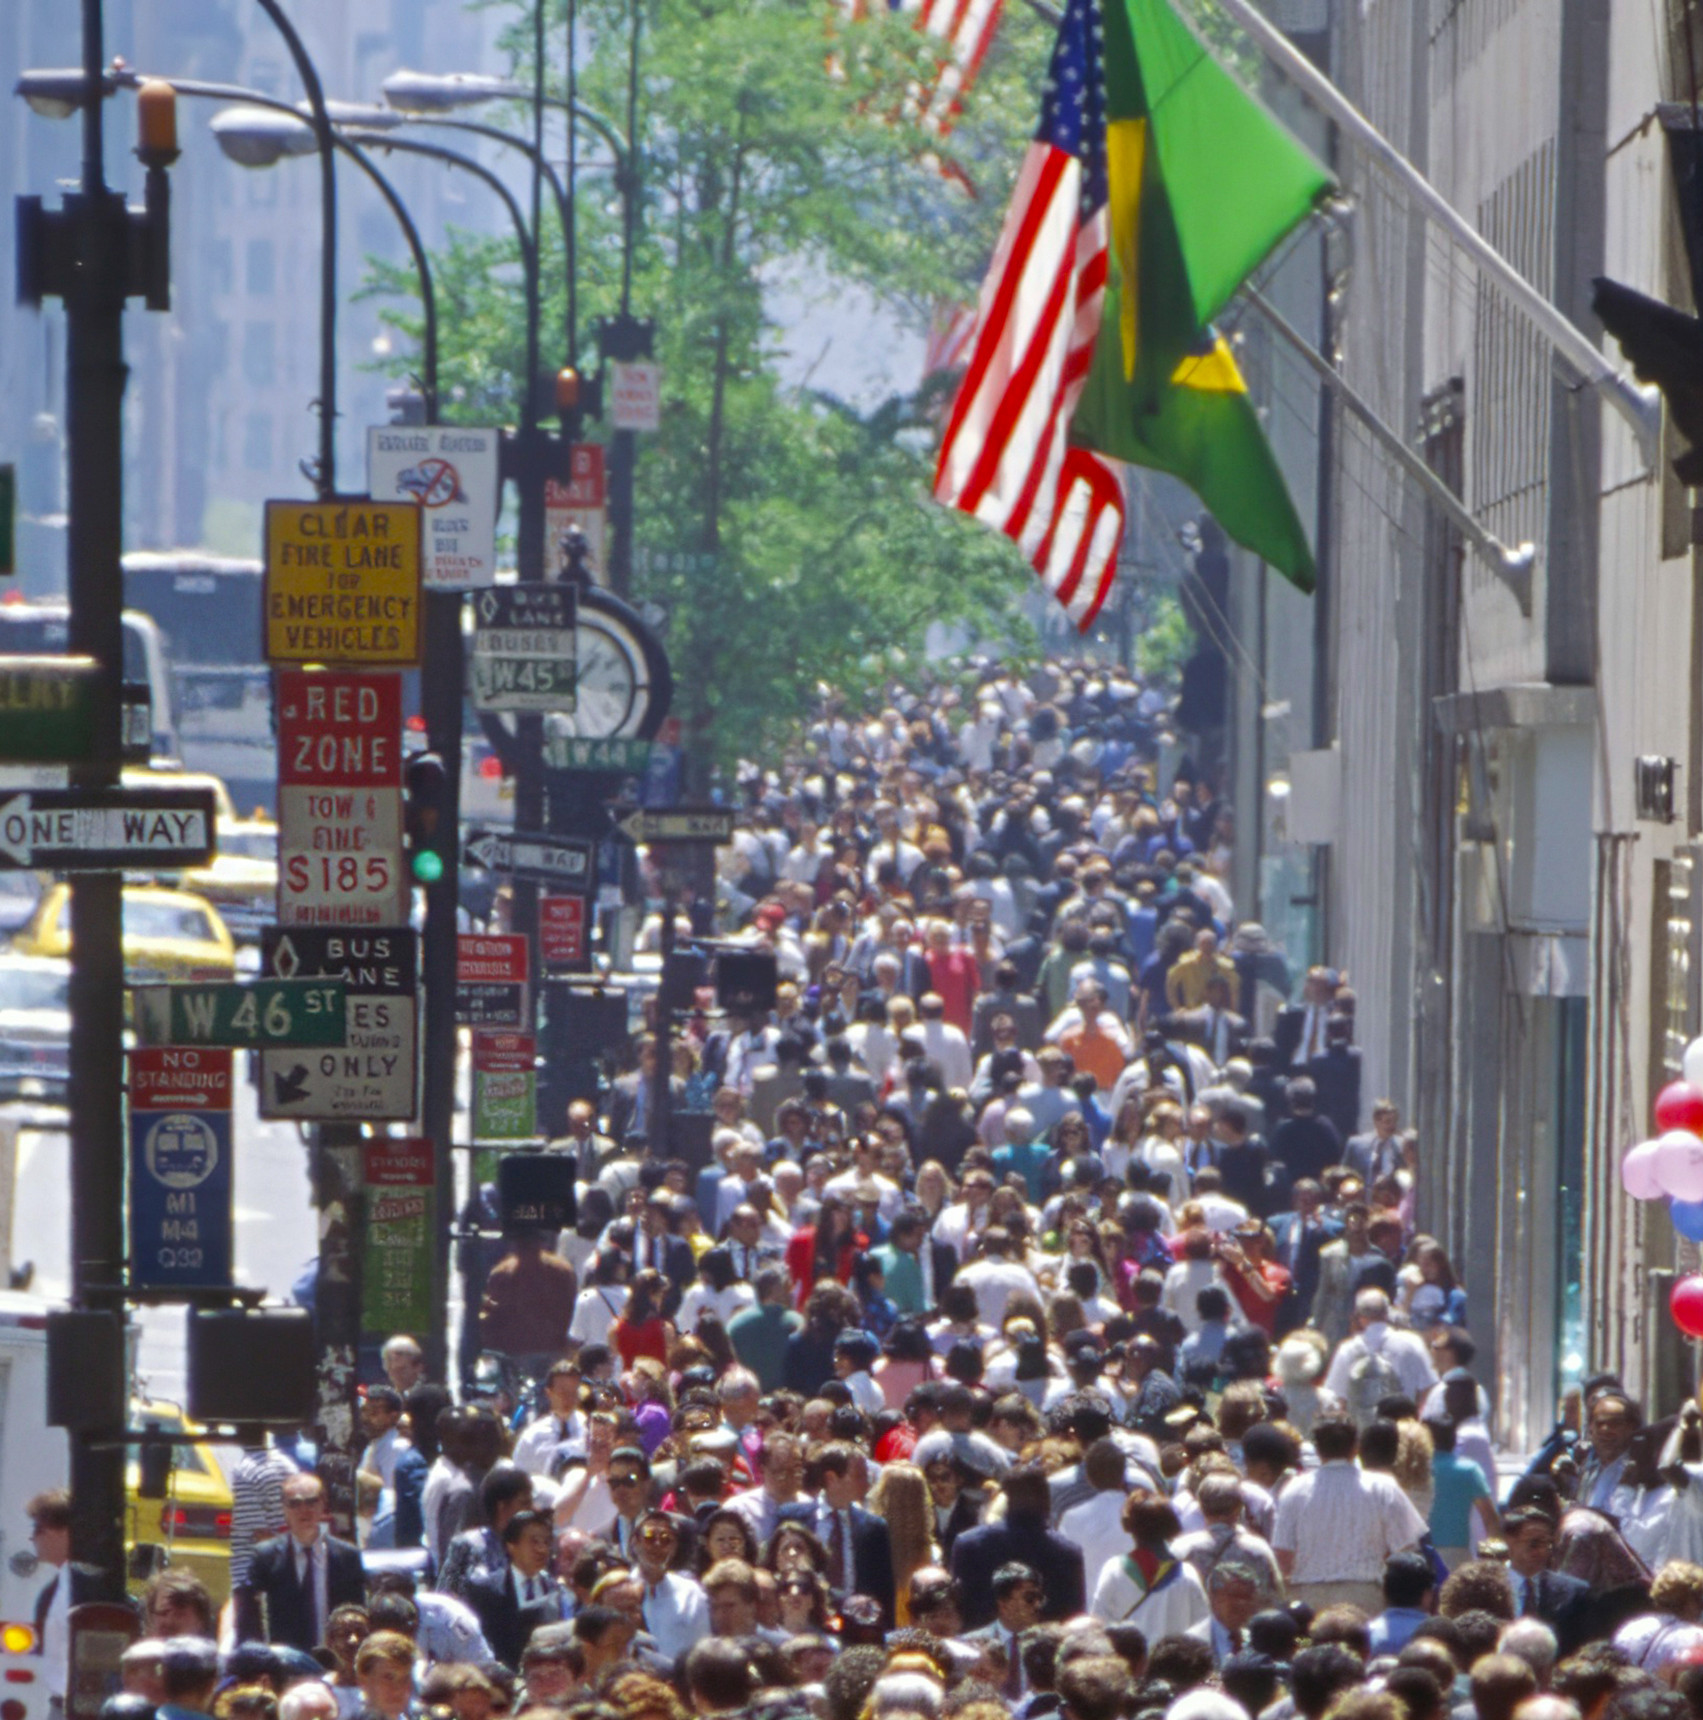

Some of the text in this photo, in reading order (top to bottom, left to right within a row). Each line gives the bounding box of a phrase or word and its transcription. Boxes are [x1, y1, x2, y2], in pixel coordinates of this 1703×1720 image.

[298, 513, 390, 538] CLEAR
[281, 542, 334, 567] FIRE
[346, 544, 404, 569] LANE
[271, 592, 412, 619] EMERGENCY
[285, 625, 401, 651] VEHICLES
[496, 661, 515, 690] W
[516, 661, 554, 692] 45
[306, 686, 379, 723] RED
[295, 734, 388, 774] ZONE
[308, 795, 353, 819] TOW
[4, 812, 195, 845] ONE WAY
[327, 938, 391, 959] BUS
[319, 966, 400, 987] ANE
[183, 988, 337, 1042] W 46 ST
[162, 1051, 200, 1069] NO
[319, 1054, 399, 1078] ONLY
[135, 1072, 228, 1090] STANDING
